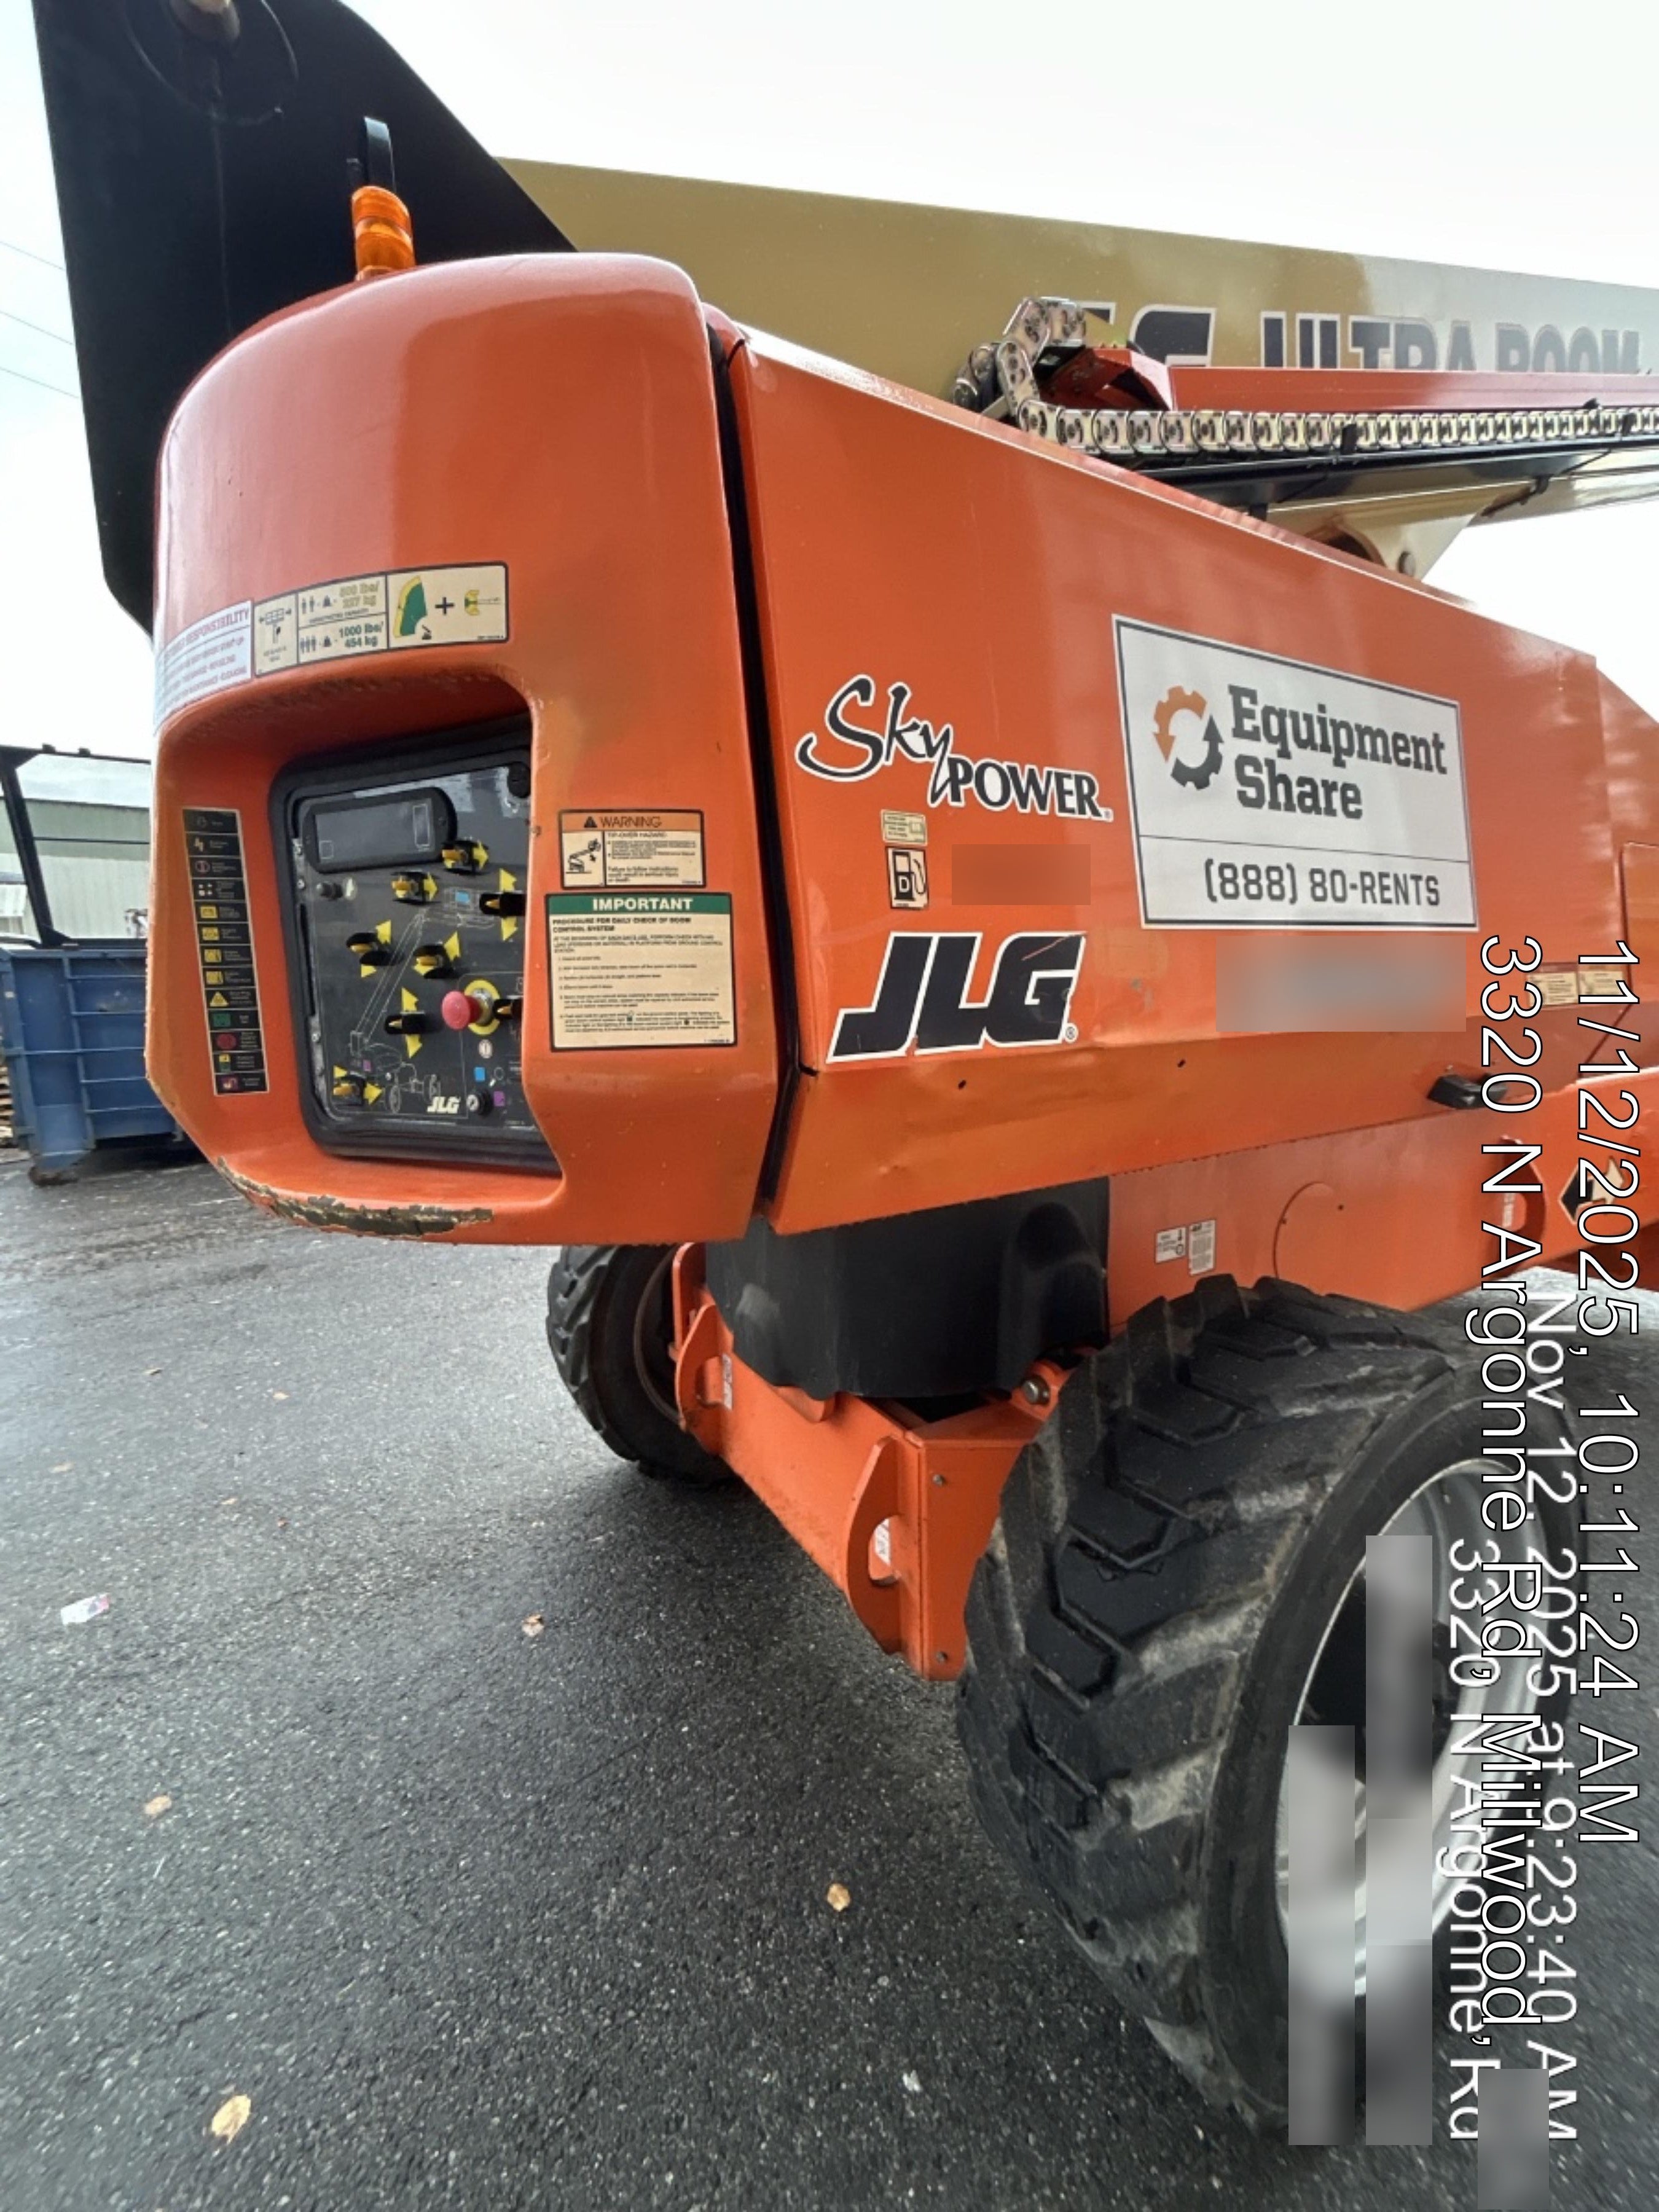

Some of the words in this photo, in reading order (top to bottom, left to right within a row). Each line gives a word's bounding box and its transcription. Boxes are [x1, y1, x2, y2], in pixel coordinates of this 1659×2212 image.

[339, 624, 362, 638] 1000
[345, 637, 361, 648] 454
[365, 635, 378, 648] kg
[1228, 683, 1448, 774] Equipment
[1234, 753, 1363, 820] Share
[600, 815, 662, 828] WARNING
[898, 876, 910, 892] D
[1205, 858, 1298, 905] (888)
[1309, 868, 1440, 907] 80-RENTS
[592, 898, 694, 911] IMPORTANT
[825, 930, 1089, 1064] JLG
[426, 1096, 461, 1114] JLG
